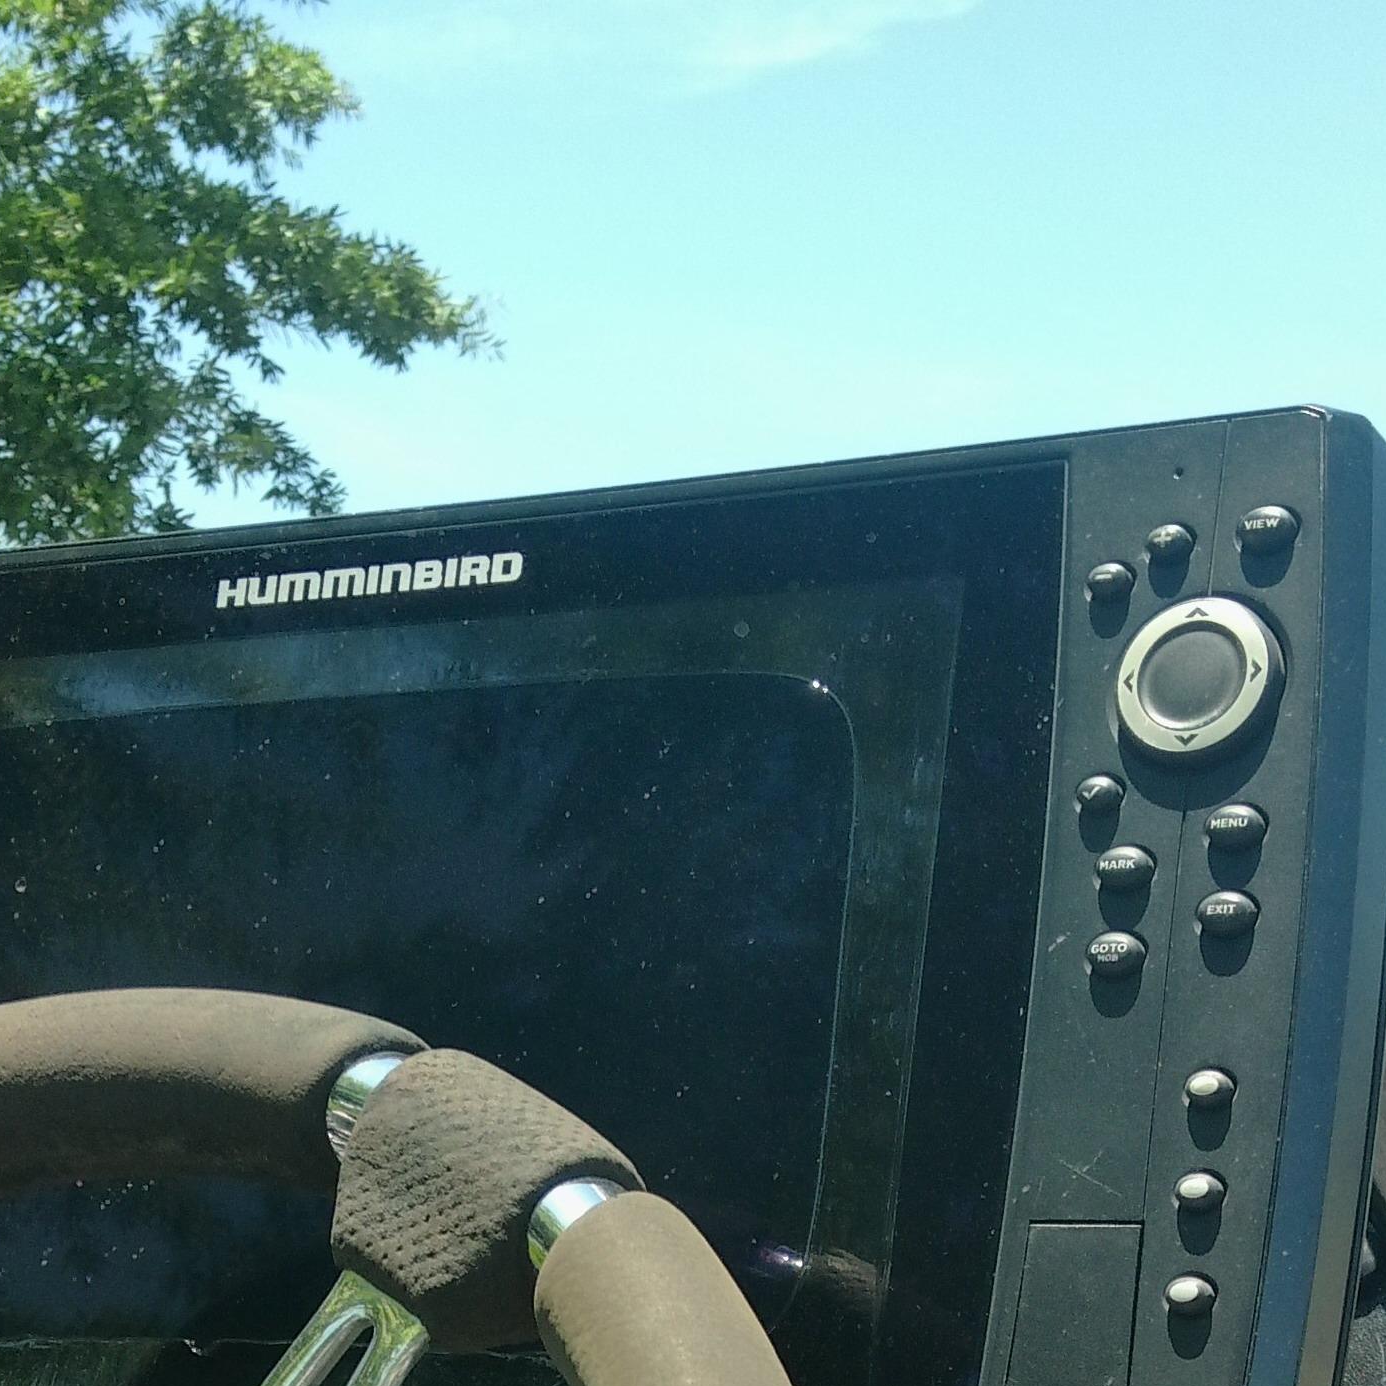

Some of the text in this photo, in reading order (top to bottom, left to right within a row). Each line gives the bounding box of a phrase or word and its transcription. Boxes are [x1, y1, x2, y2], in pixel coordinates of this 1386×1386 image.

[1244, 518, 1280, 530] VIEW
[216, 551, 523, 609] HUMMINBIRD
[1210, 816, 1249, 830] MENU
[1099, 858, 1136, 871] MARK
[1206, 904, 1237, 915] EXIT
